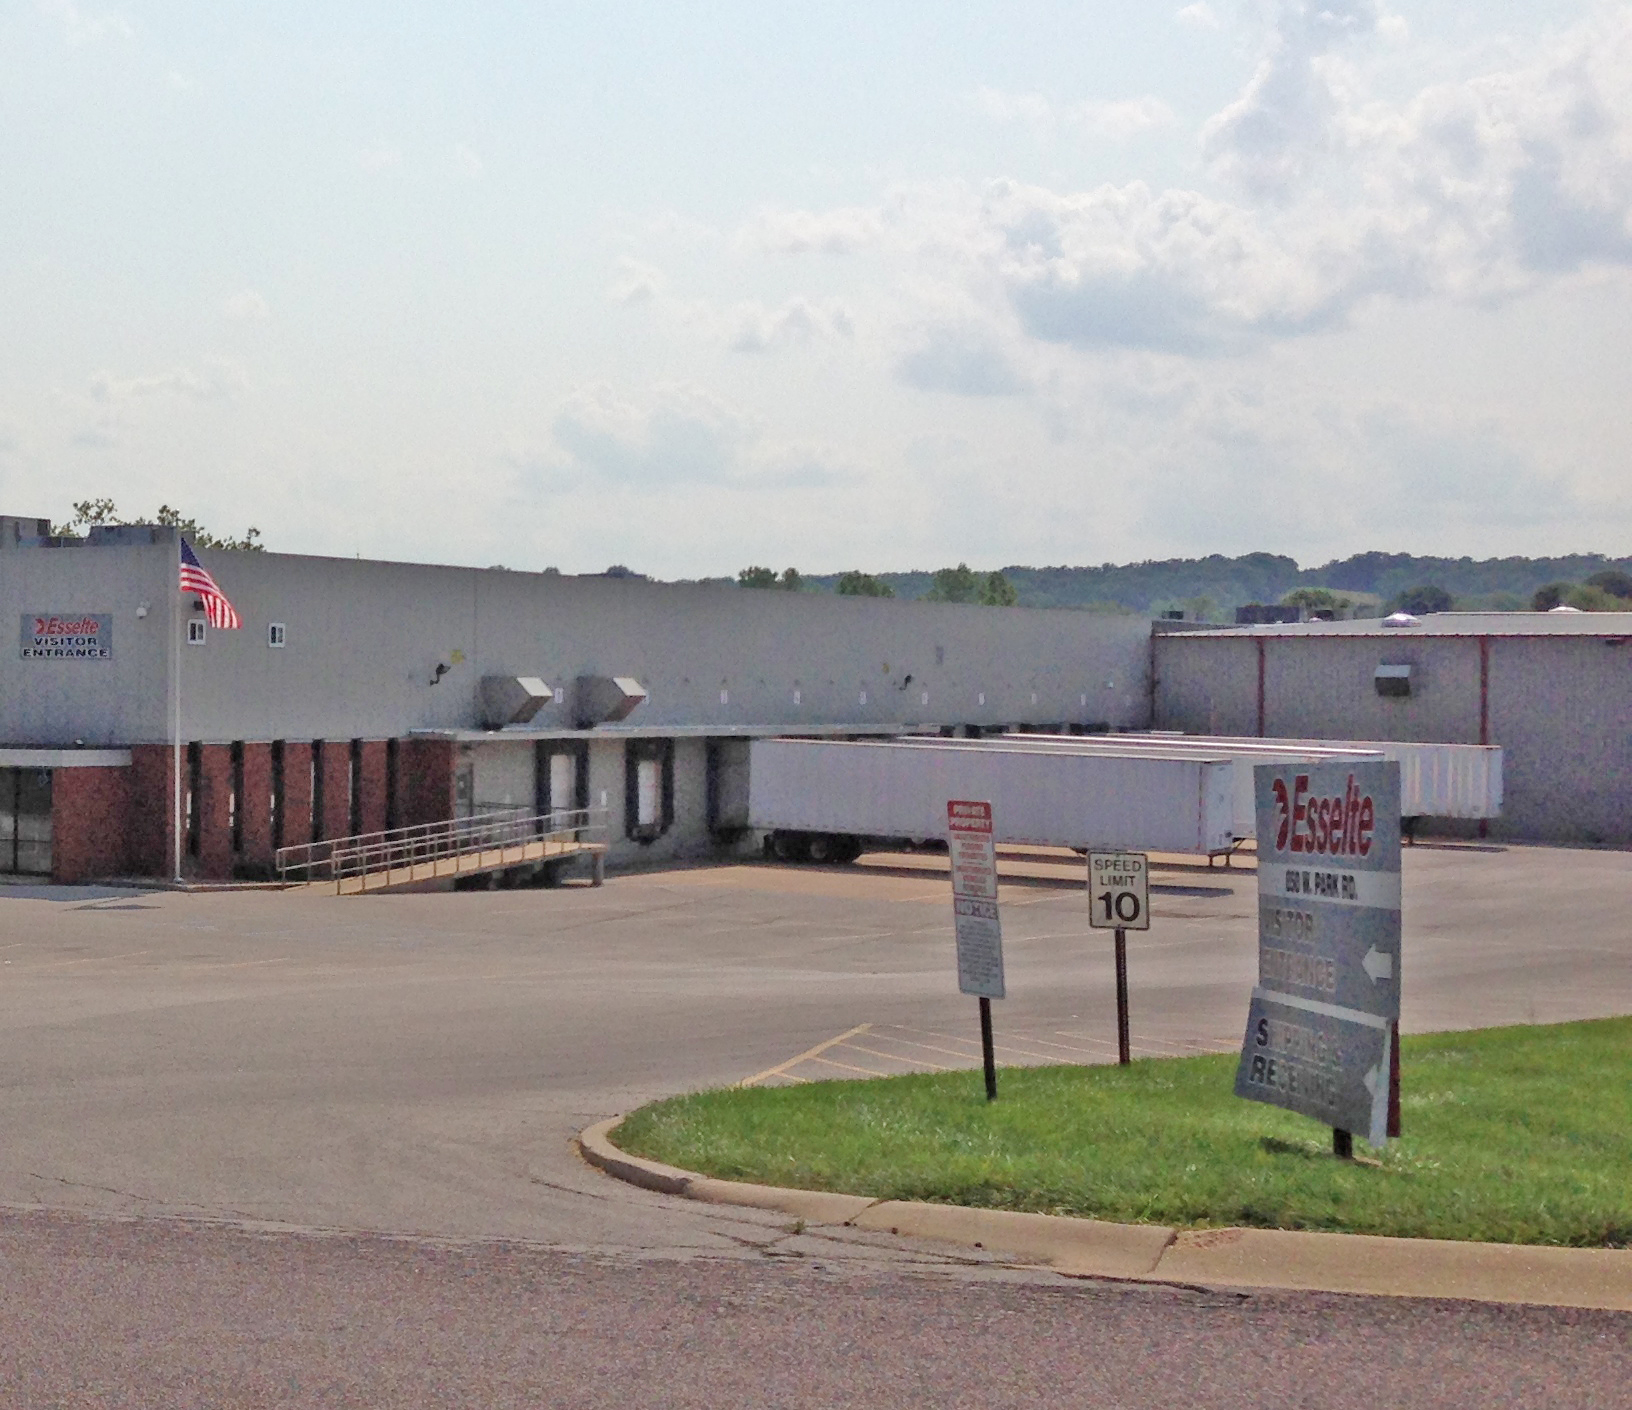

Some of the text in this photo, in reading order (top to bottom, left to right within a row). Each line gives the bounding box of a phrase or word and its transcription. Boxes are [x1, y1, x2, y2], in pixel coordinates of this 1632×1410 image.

[46, 616, 99, 635] Esselte
[34, 637, 97, 646] VISITOR
[23, 648, 108, 657] ENTRANCE
[1289, 773, 1374, 857] Esselte
[1094, 858, 1142, 872] SPEED
[1100, 875, 1136, 888] LIMIT
[1314, 871, 1339, 899] PARK
[1098, 891, 1141, 922] 10
